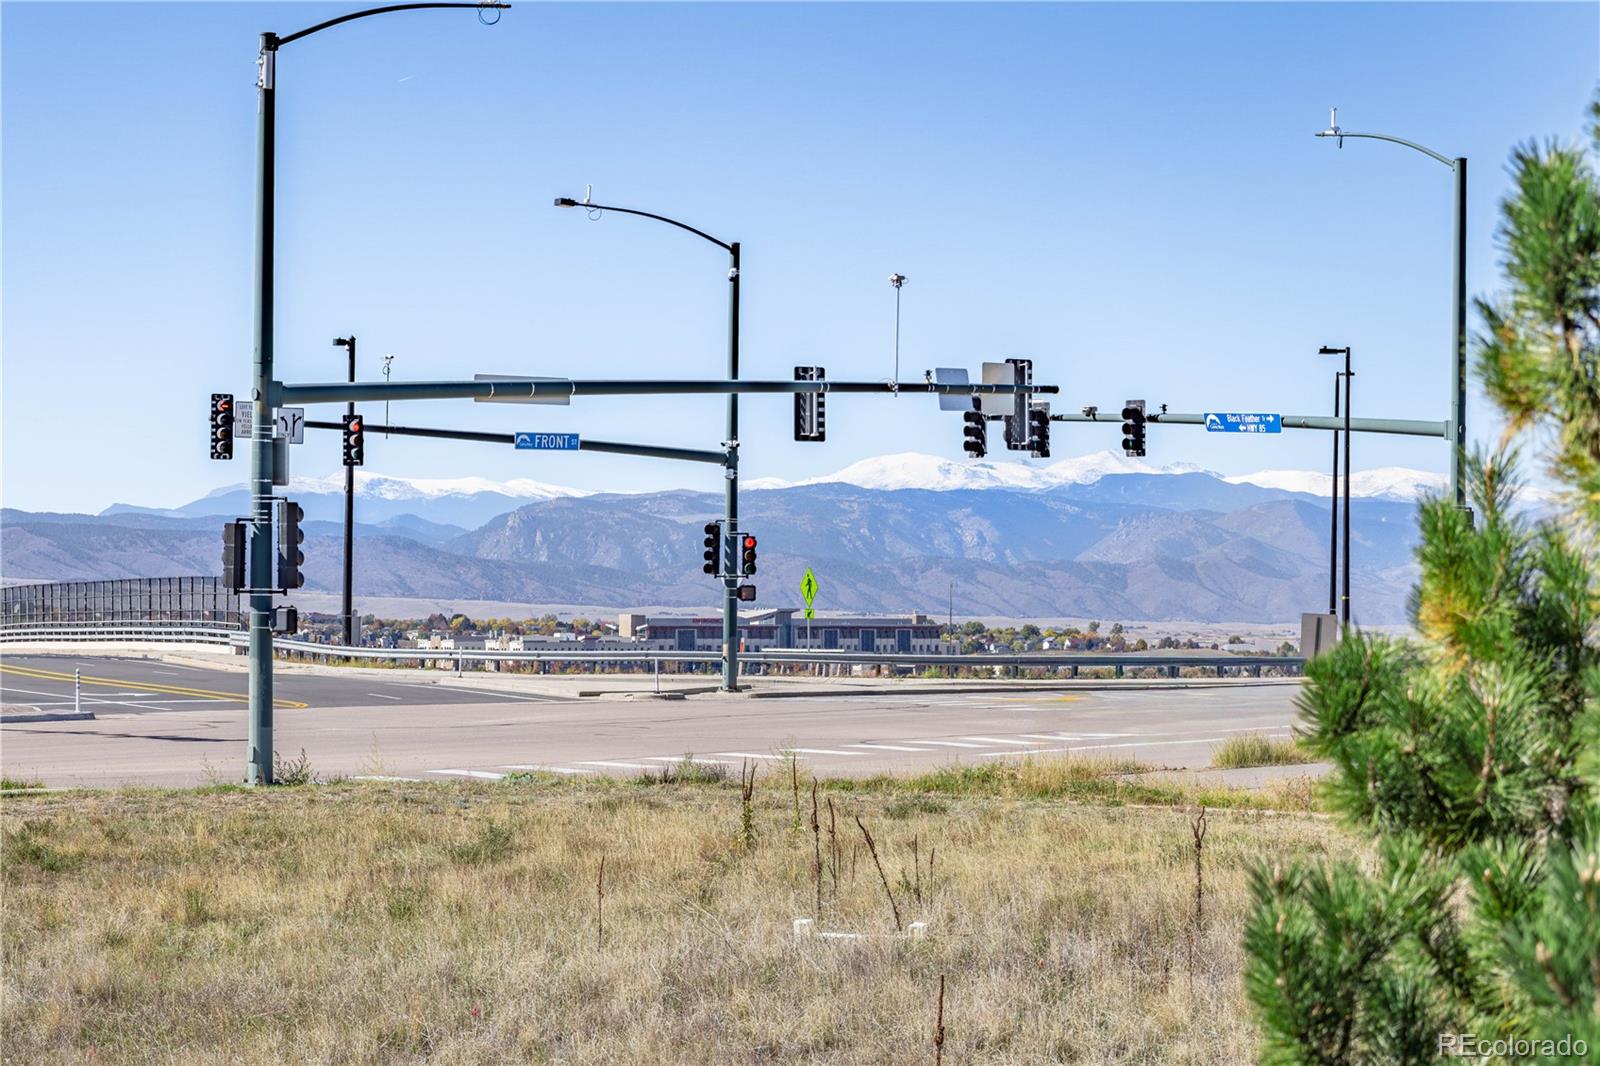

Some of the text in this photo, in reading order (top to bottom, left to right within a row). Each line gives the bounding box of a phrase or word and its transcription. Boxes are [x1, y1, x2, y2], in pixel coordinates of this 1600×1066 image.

[1226, 414, 1240, 422] Black
[1246, 424, 1258, 432] HWY
[535, 434, 570, 449] FRONT
